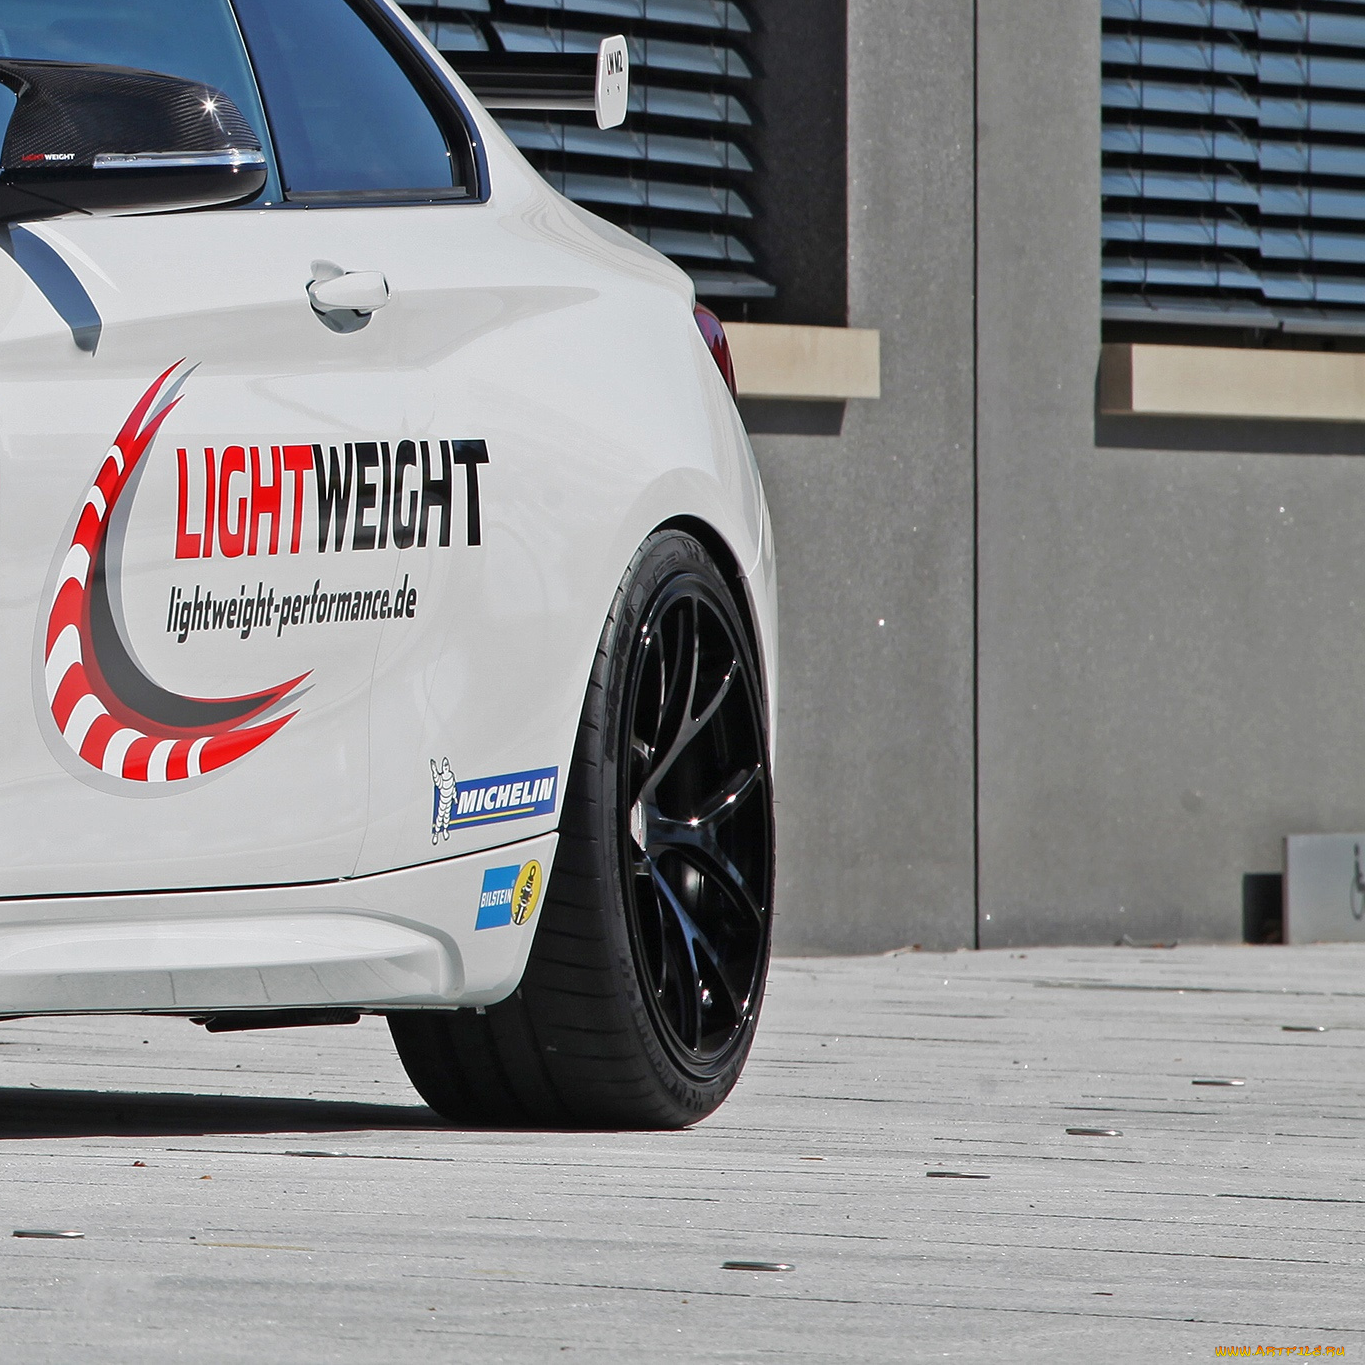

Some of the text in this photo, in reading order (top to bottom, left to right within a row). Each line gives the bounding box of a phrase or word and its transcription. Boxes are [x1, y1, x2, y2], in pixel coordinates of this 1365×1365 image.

[174, 439, 491, 559] LIGHTWEIGHT
[166, 573, 417, 644] lightweight-performance.de
[456, 777, 555, 815] MICHELIN
[480, 887, 514, 908] BILSTEIN
